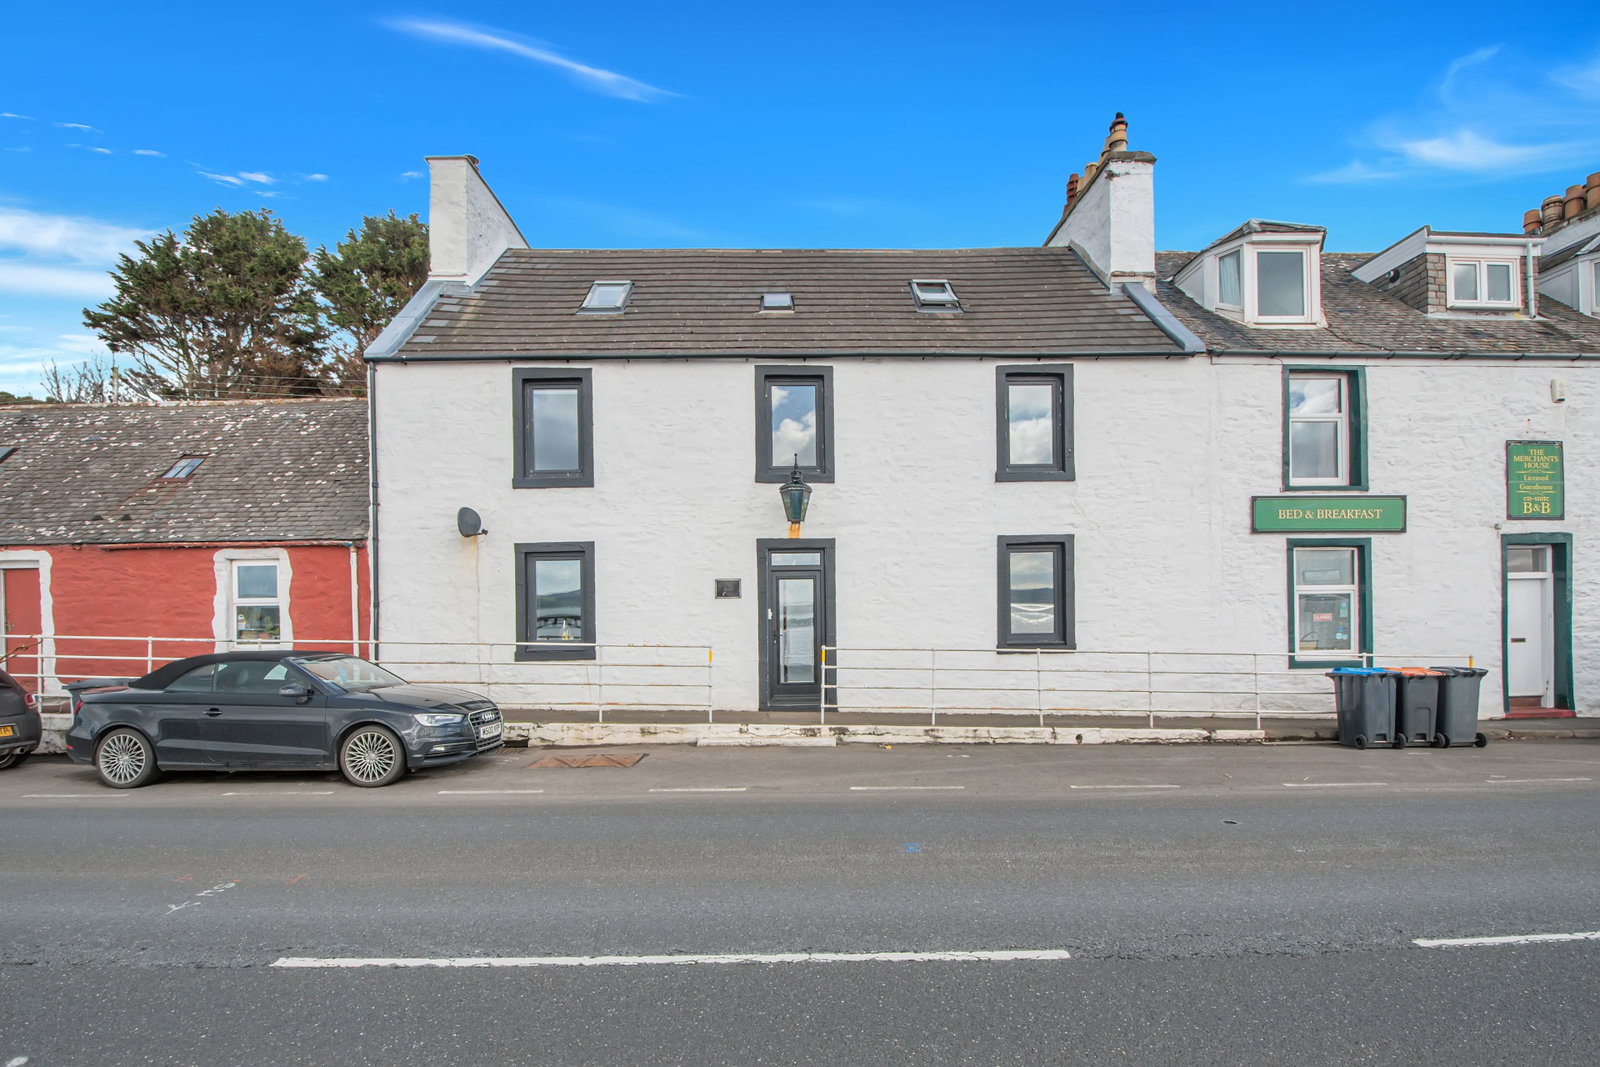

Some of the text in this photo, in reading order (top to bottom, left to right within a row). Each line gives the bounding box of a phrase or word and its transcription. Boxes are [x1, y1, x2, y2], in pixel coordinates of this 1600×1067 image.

[1523, 502, 1550, 513] B&B
[1278, 509, 1382, 519] BED & BREAKFAST
